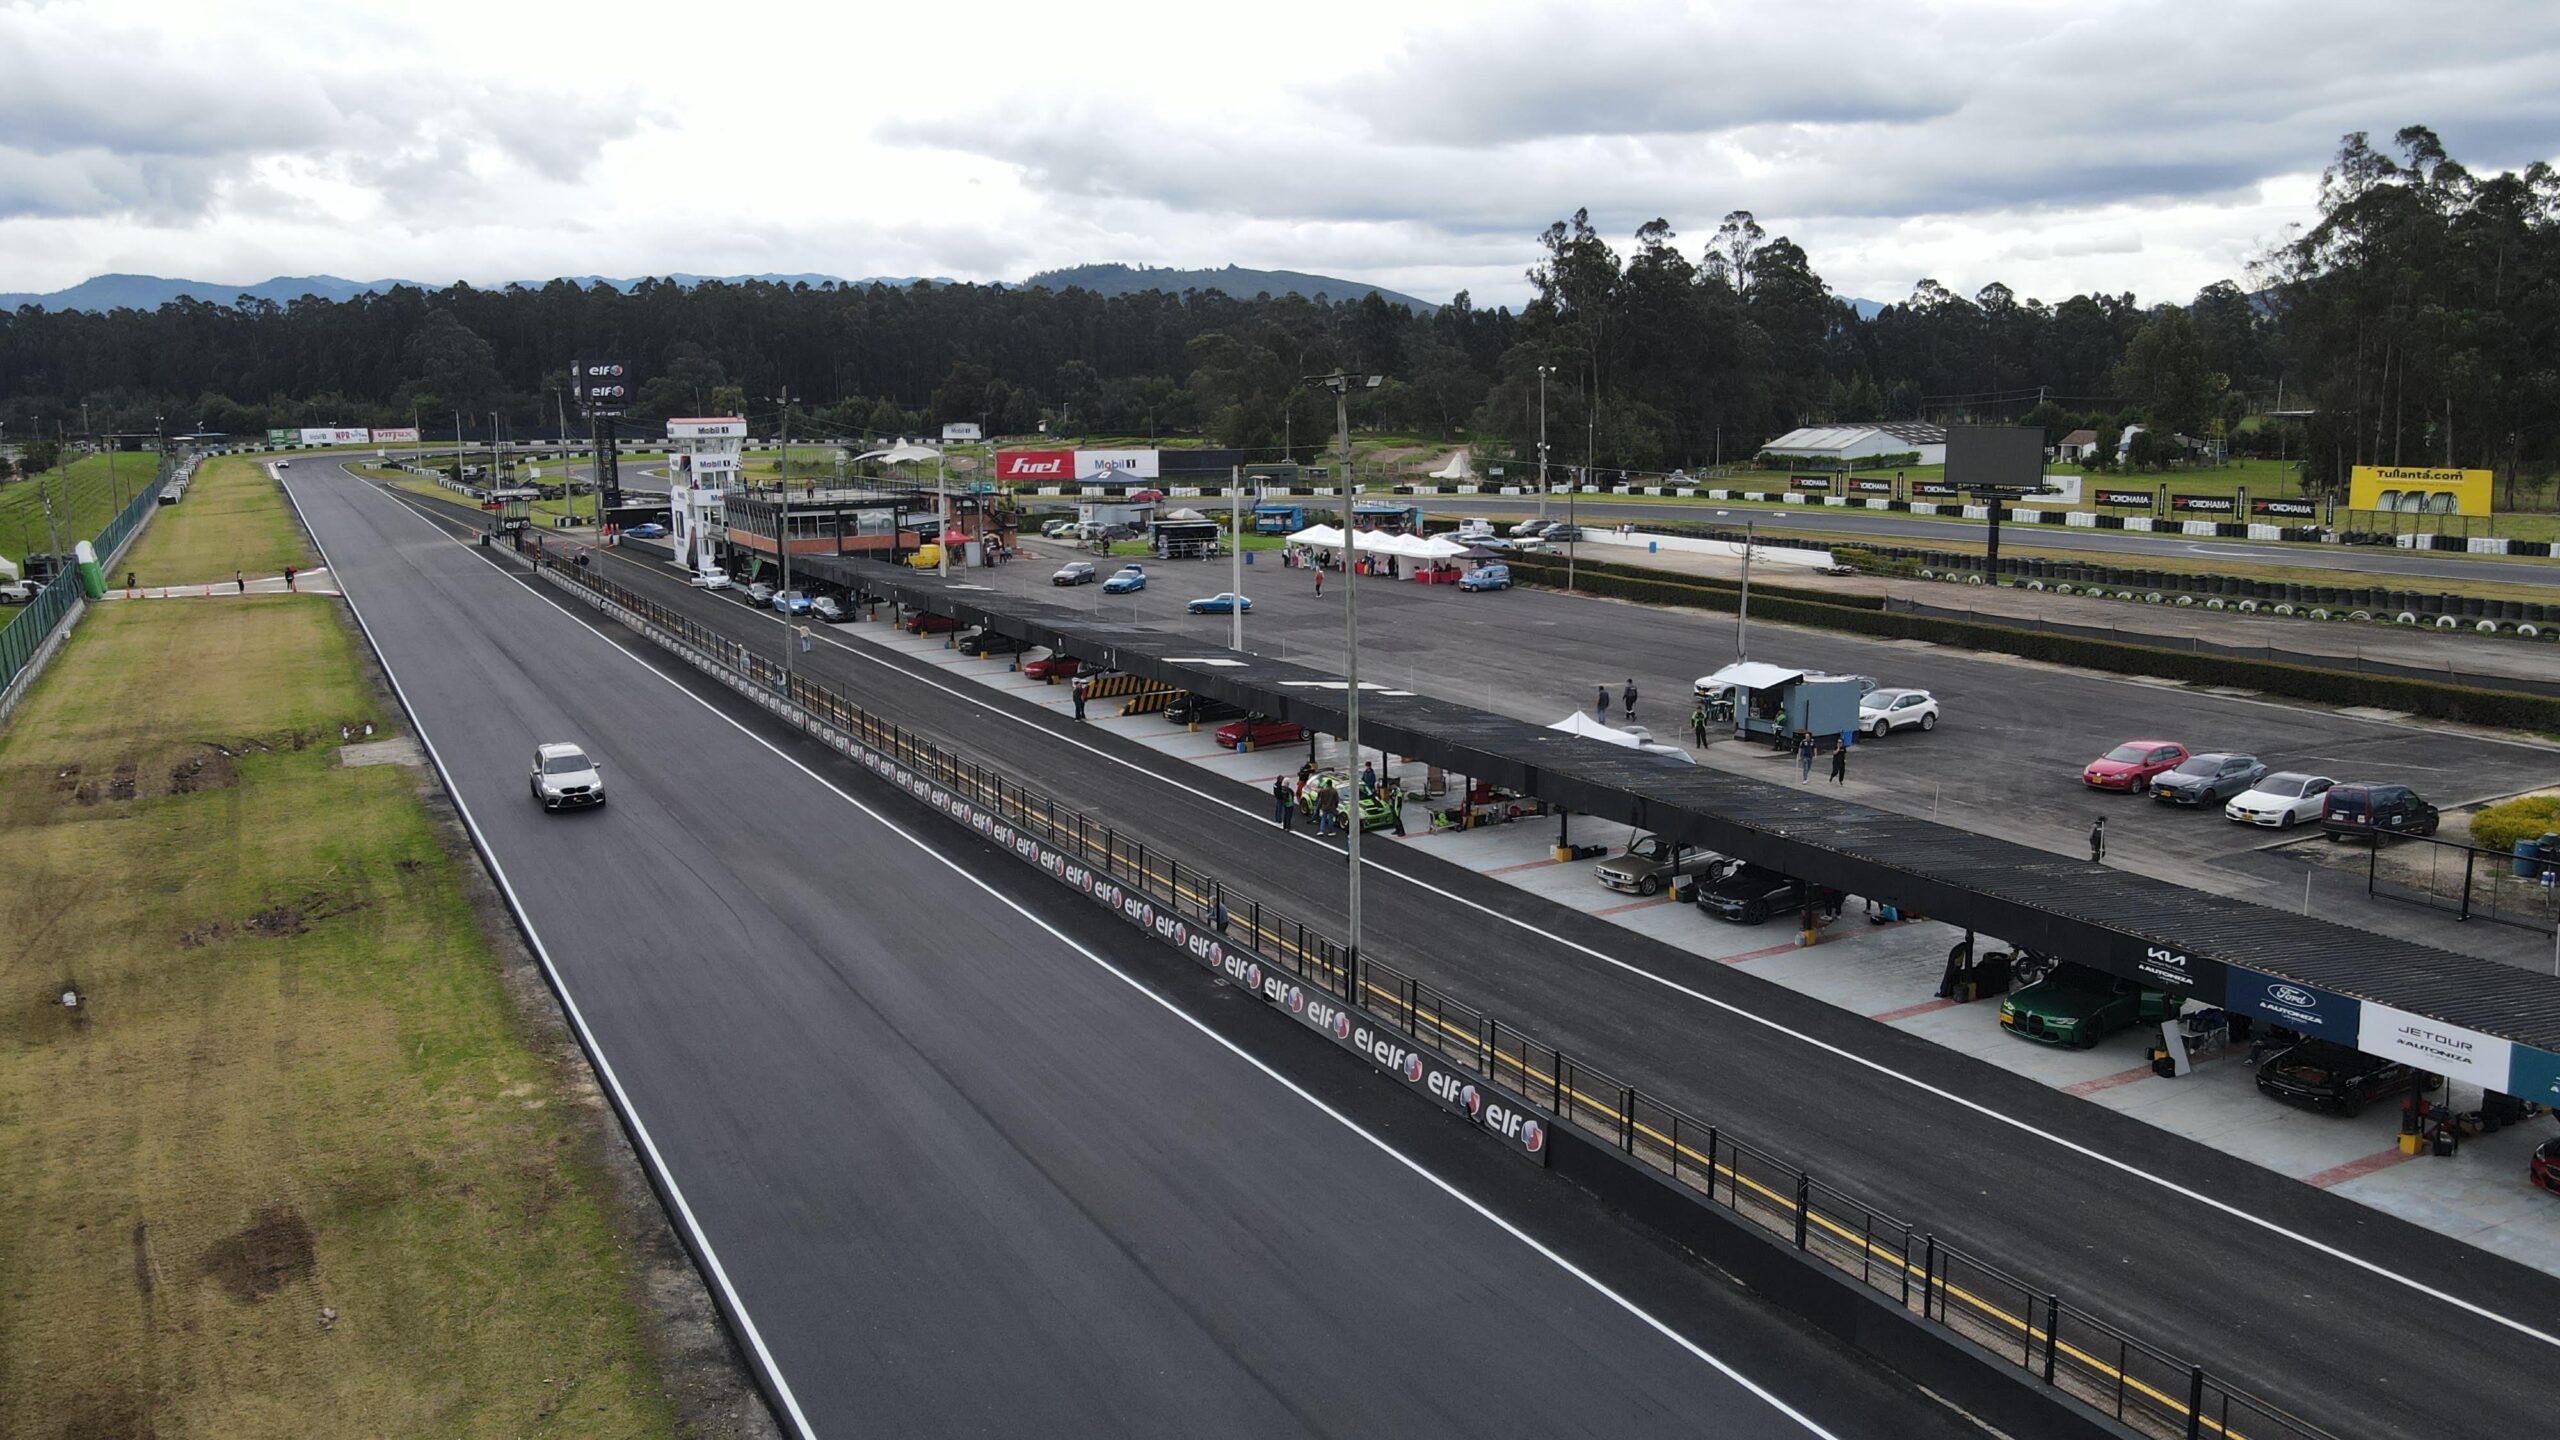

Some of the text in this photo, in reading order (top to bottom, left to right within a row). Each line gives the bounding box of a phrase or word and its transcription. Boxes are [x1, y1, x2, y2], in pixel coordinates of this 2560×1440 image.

[589, 366, 611, 376] elf
[591, 387, 613, 397] elf
[1007, 457, 1061, 474] fuel
[1095, 459, 1125, 471] Mobil
[1800, 479, 1828, 487] YOKOHAMA
[1859, 482, 1889, 490] YOKOHAMA
[2110, 494, 2149, 504] YOKOHAMA
[2188, 499, 2230, 509] YOKOHAMA
[2268, 503, 2312, 514] YOKOHAMA
[836, 736, 845, 748] elf
[850, 744, 860, 757] elf
[865, 752, 876, 767] elf
[880, 761, 891, 776] elf
[896, 770, 908, 786] elf
[914, 780, 925, 796] elf
[931, 790, 944, 807] elf
[951, 801, 964, 818] elf
[972, 812, 986, 830] elf
[994, 824, 1008, 842] elf
[1016, 837, 1031, 856] elf
[1040, 851, 1056, 870] elf
[1066, 865, 1083, 886] elf
[1094, 881, 1112, 902] elf
[1124, 897, 1143, 920] elf
[1156, 914, 1175, 938] elf
[1188, 934, 1211, 959] elf
[1224, 955, 1248, 981] elf
[1264, 976, 1290, 1004] elf
[1308, 1001, 1335, 1029] elf
[1374, 1040, 1406, 1071] elf
[1428, 1070, 1462, 1103] elf
[1485, 1104, 1523, 1139] elf
[2276, 986, 2308, 1005] Ford
[2398, 1026, 2473, 1051] JETOUR
[2404, 1040, 2472, 1064] AUTONIZA
